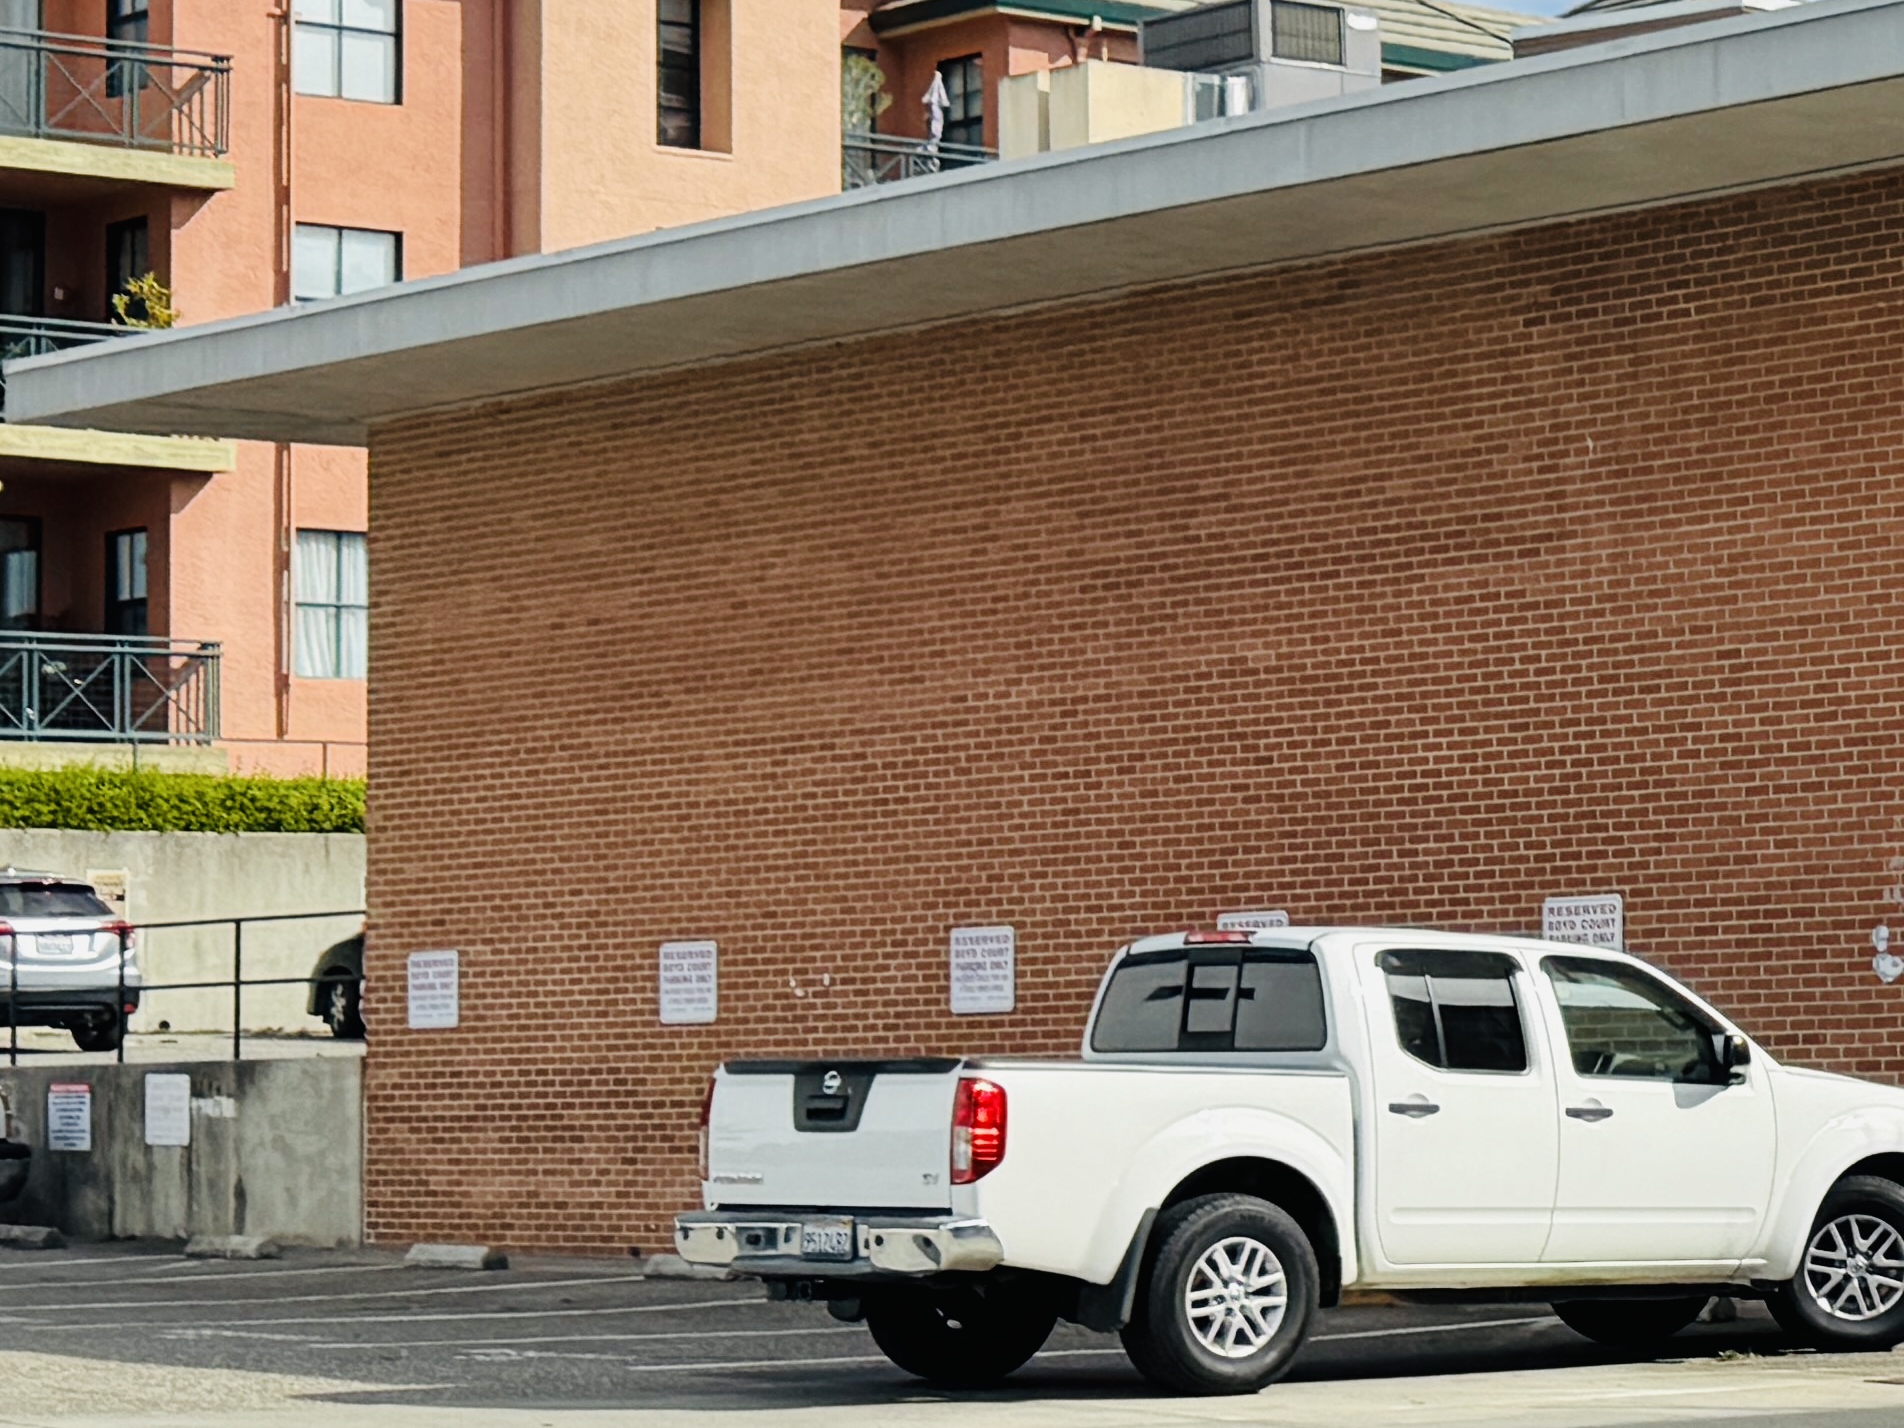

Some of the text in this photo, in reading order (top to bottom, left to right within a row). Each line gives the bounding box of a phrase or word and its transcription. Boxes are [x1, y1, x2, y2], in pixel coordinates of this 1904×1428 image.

[1547, 904, 1617, 918] RESERVED
[1548, 918, 1616, 932] BOYD COURT
